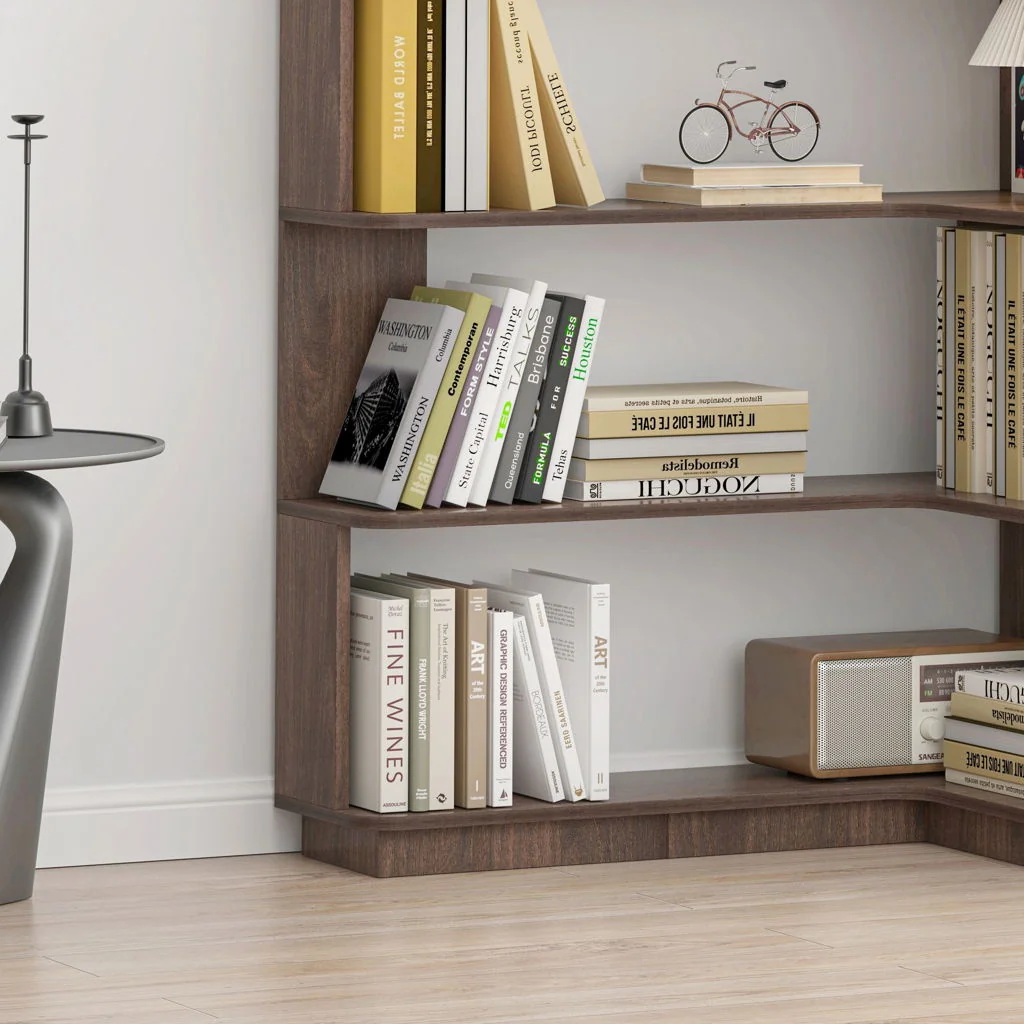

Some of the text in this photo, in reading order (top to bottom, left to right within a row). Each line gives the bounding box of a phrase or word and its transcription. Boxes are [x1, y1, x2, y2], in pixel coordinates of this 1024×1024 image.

[378, 319, 433, 341] WASHINGTON
[388, 341, 408, 353] Columbia
[435, 328, 453, 363] Columbia
[447, 322, 479, 397] Contemporan
[486, 305, 523, 388] Harrisburg
[507, 306, 540, 390] TALKS
[527, 315, 555, 385] Brisbane
[560, 315, 578, 367] SUCCESS
[572, 317, 599, 382] Houston
[460, 326, 495, 417] FORM STYLE
[550, 384, 562, 410] FOR
[957, 294, 966, 441] IL ÉTAIT UNE FOIS LE CAFÉ
[1007, 299, 1017, 449] IL ÉTAIT UNE FOIS LE CAFÉ
[391, 396, 430, 482] WASHINGTON
[458, 411, 489, 489] State Capital
[495, 400, 512, 442] TED
[409, 451, 439, 497] Italia
[504, 431, 525, 489] Queensland
[532, 431, 552, 485] FORMULA
[551, 448, 568, 482] Tehas
[387, 629, 404, 686] FINE
[470, 640, 485, 675] ART
[594, 636, 608, 669] ART
[418, 659, 427, 740] FRANK LLOYD WRIGHT
[499, 629, 508, 769] GRAPHIC DESIGN REFERENCED
[531, 690, 549, 739] BORDEAUX
[553, 689, 573, 750] EERO SAARINEN
[386, 698, 404, 784] WINES
